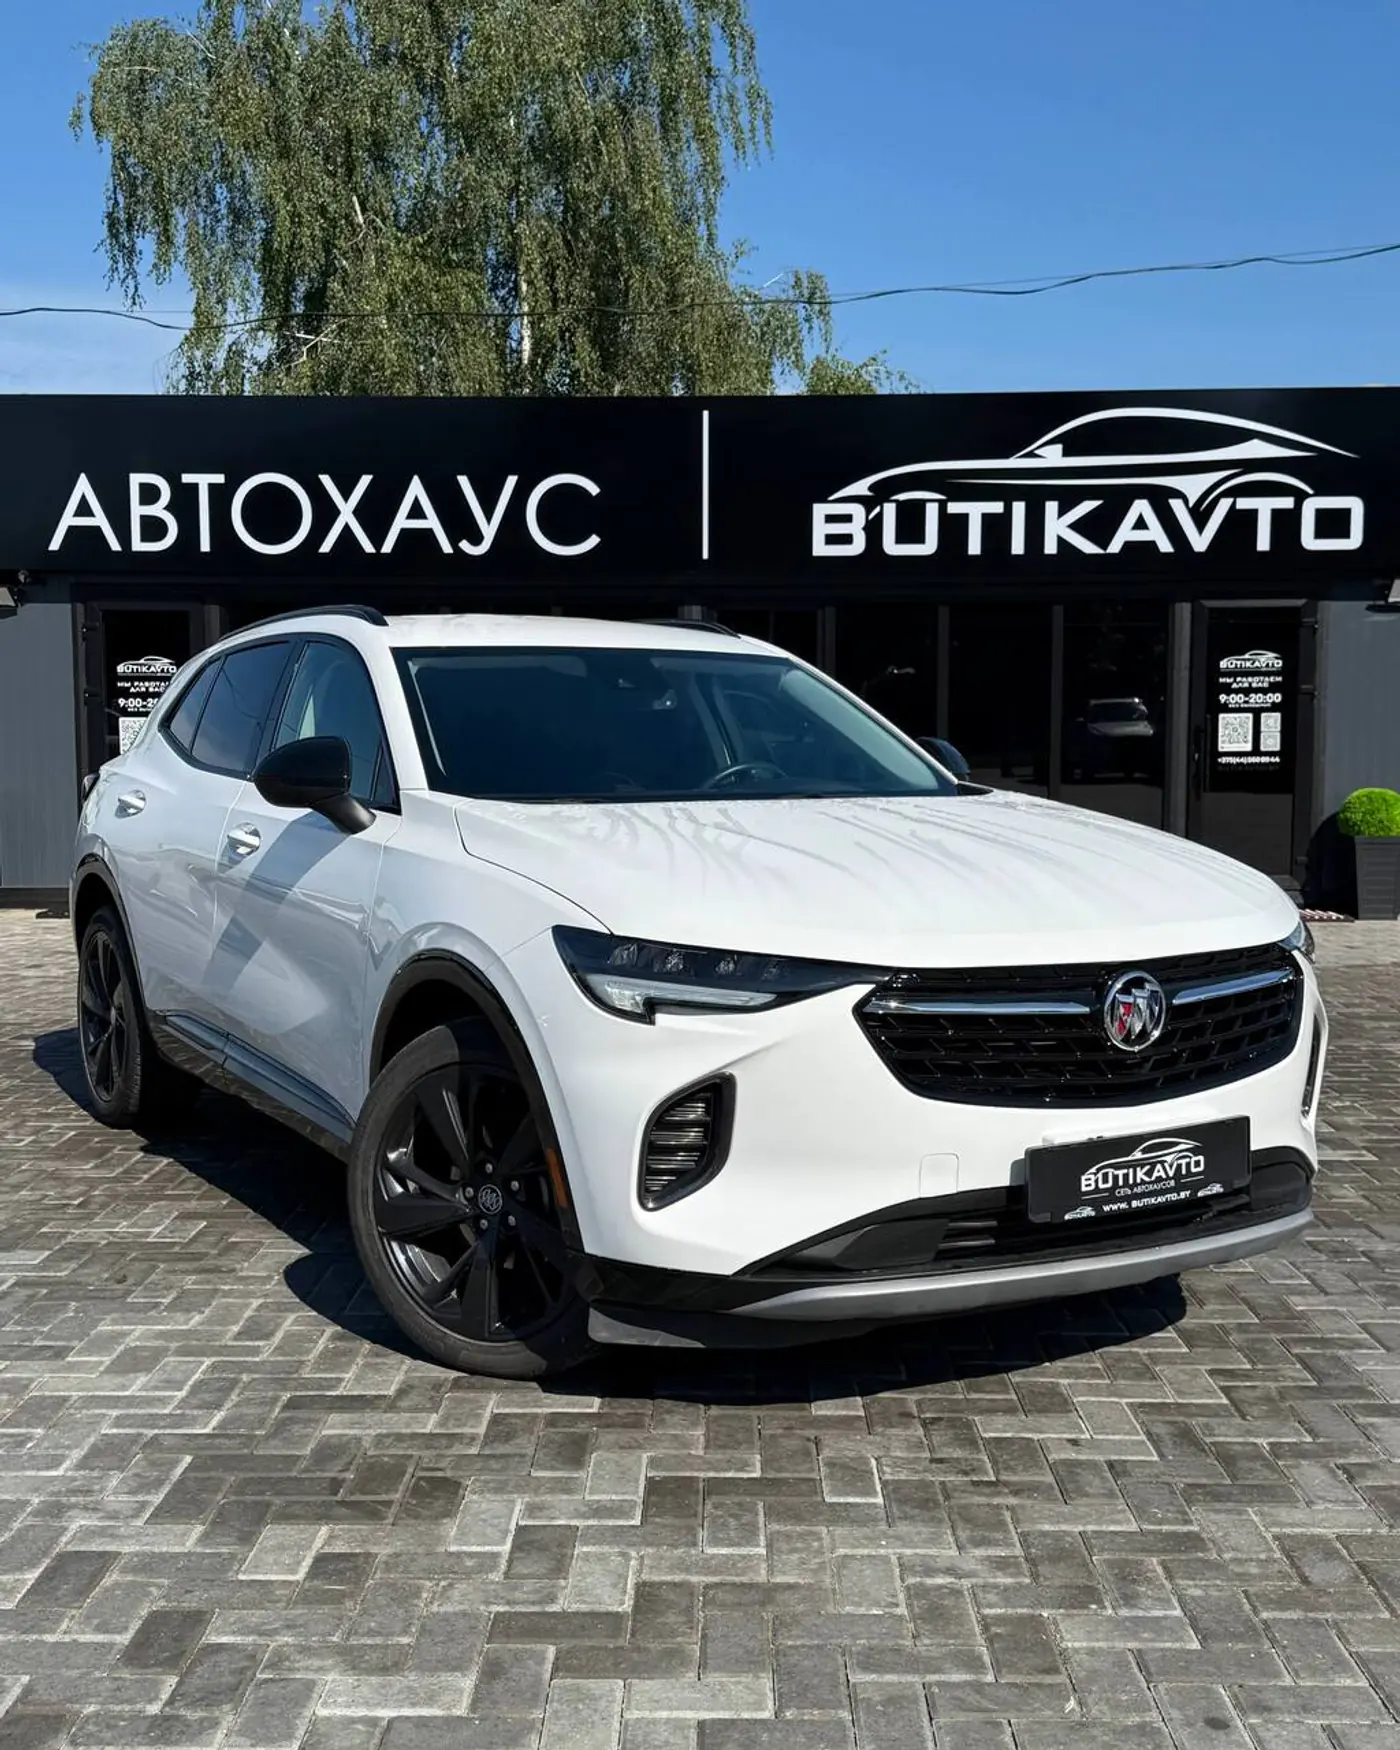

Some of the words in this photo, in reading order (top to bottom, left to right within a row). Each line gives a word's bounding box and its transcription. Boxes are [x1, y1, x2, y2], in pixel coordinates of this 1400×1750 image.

[47, 472, 602, 557] АВТОХАУС
[811, 495, 1365, 557] BUTIKAVTO
[117, 665, 177, 673] BUTIKAVTO
[1219, 660, 1282, 668] BUTIKAVTO
[1219, 693, 1282, 703] 9:00-20:00
[1081, 1155, 1205, 1191] BUTIKAVTO
